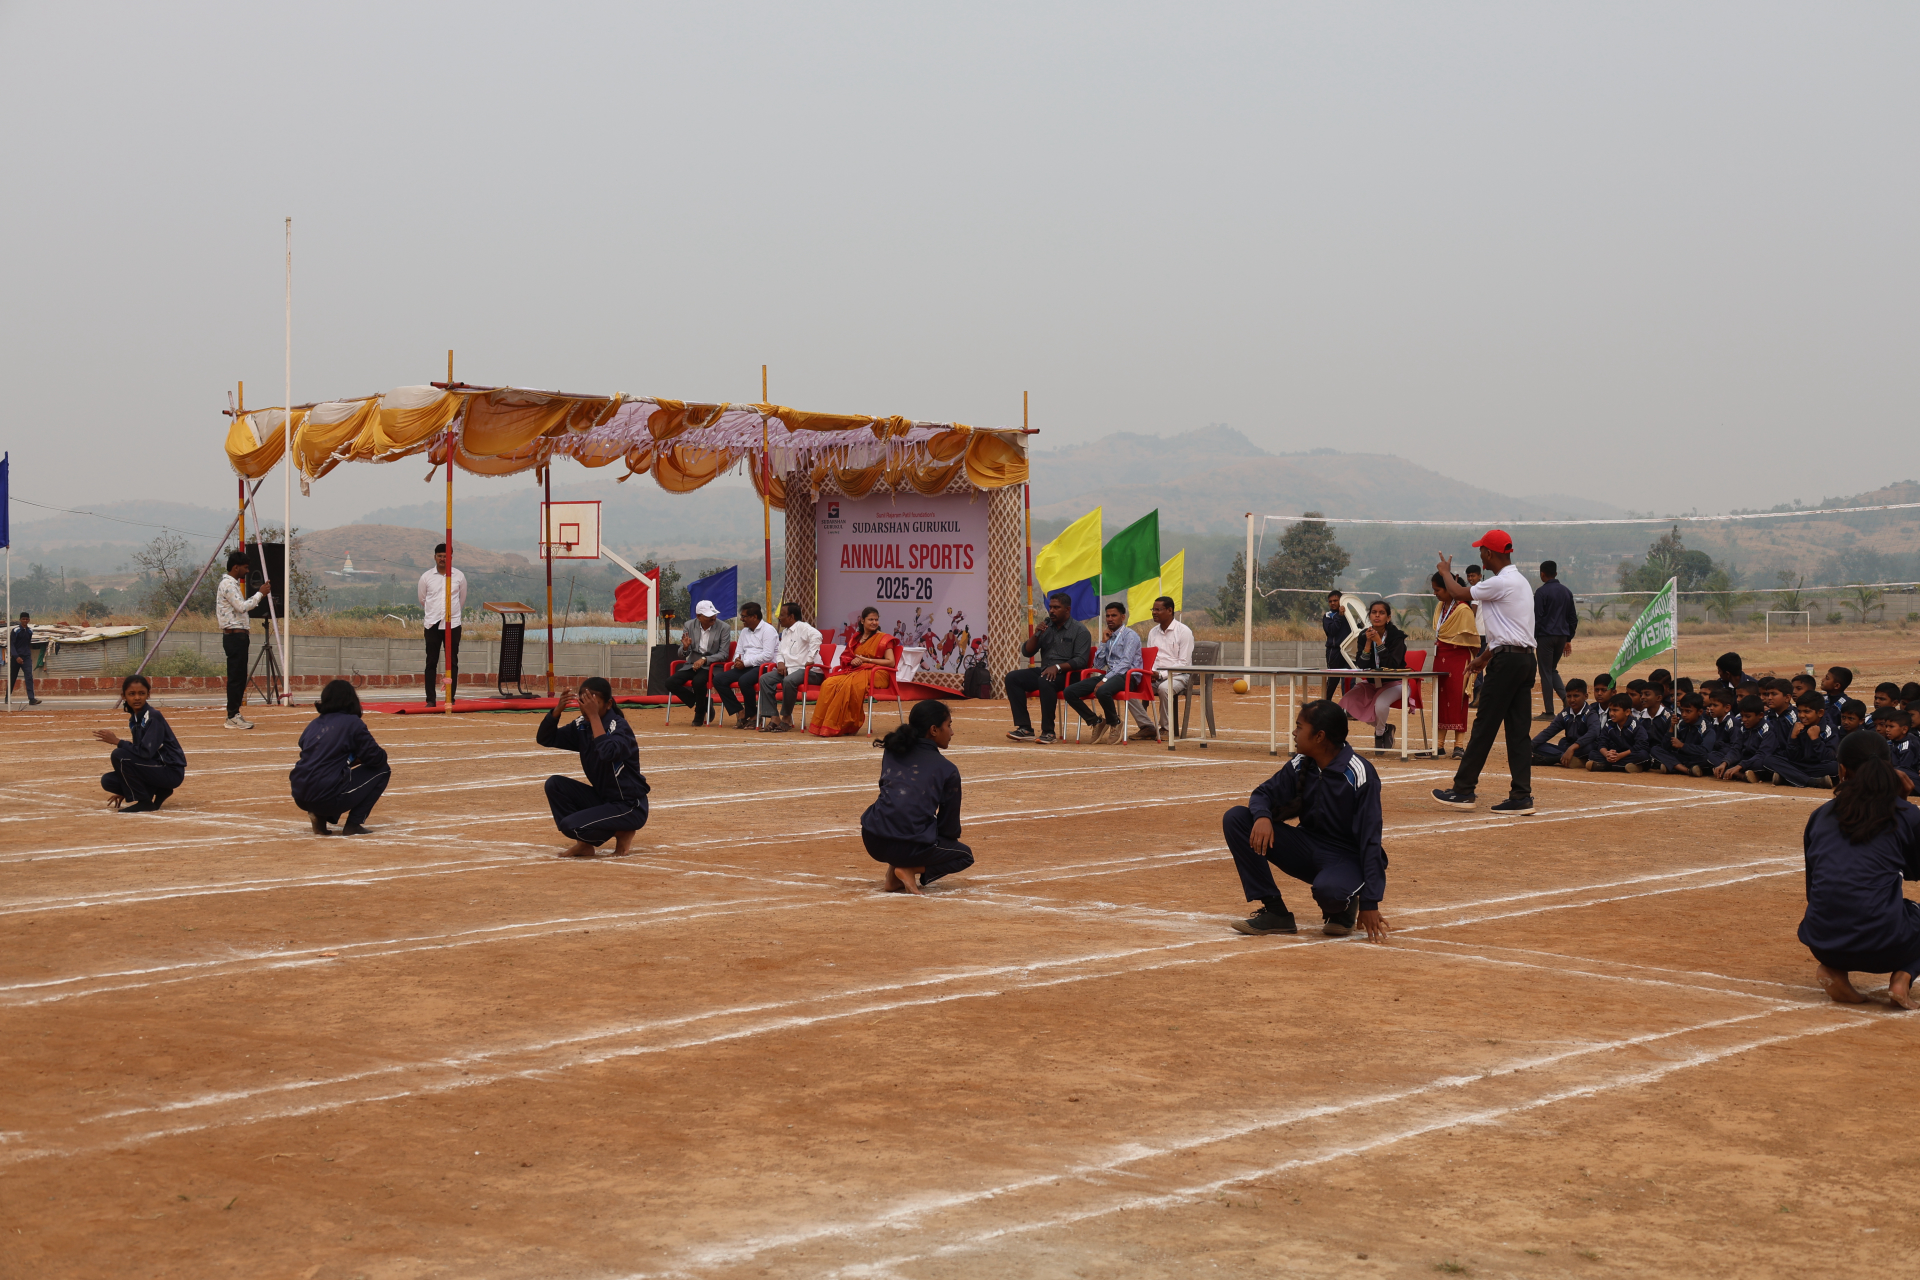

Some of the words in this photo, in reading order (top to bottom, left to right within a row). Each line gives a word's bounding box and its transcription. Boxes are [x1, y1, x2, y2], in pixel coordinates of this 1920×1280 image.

[852, 521, 910, 534] SUDARSHAN
[912, 520, 961, 533] GURUKUL
[840, 544, 904, 569] ANNUAL
[909, 543, 974, 569] SPORTS
[877, 576, 933, 600] 2025-26
